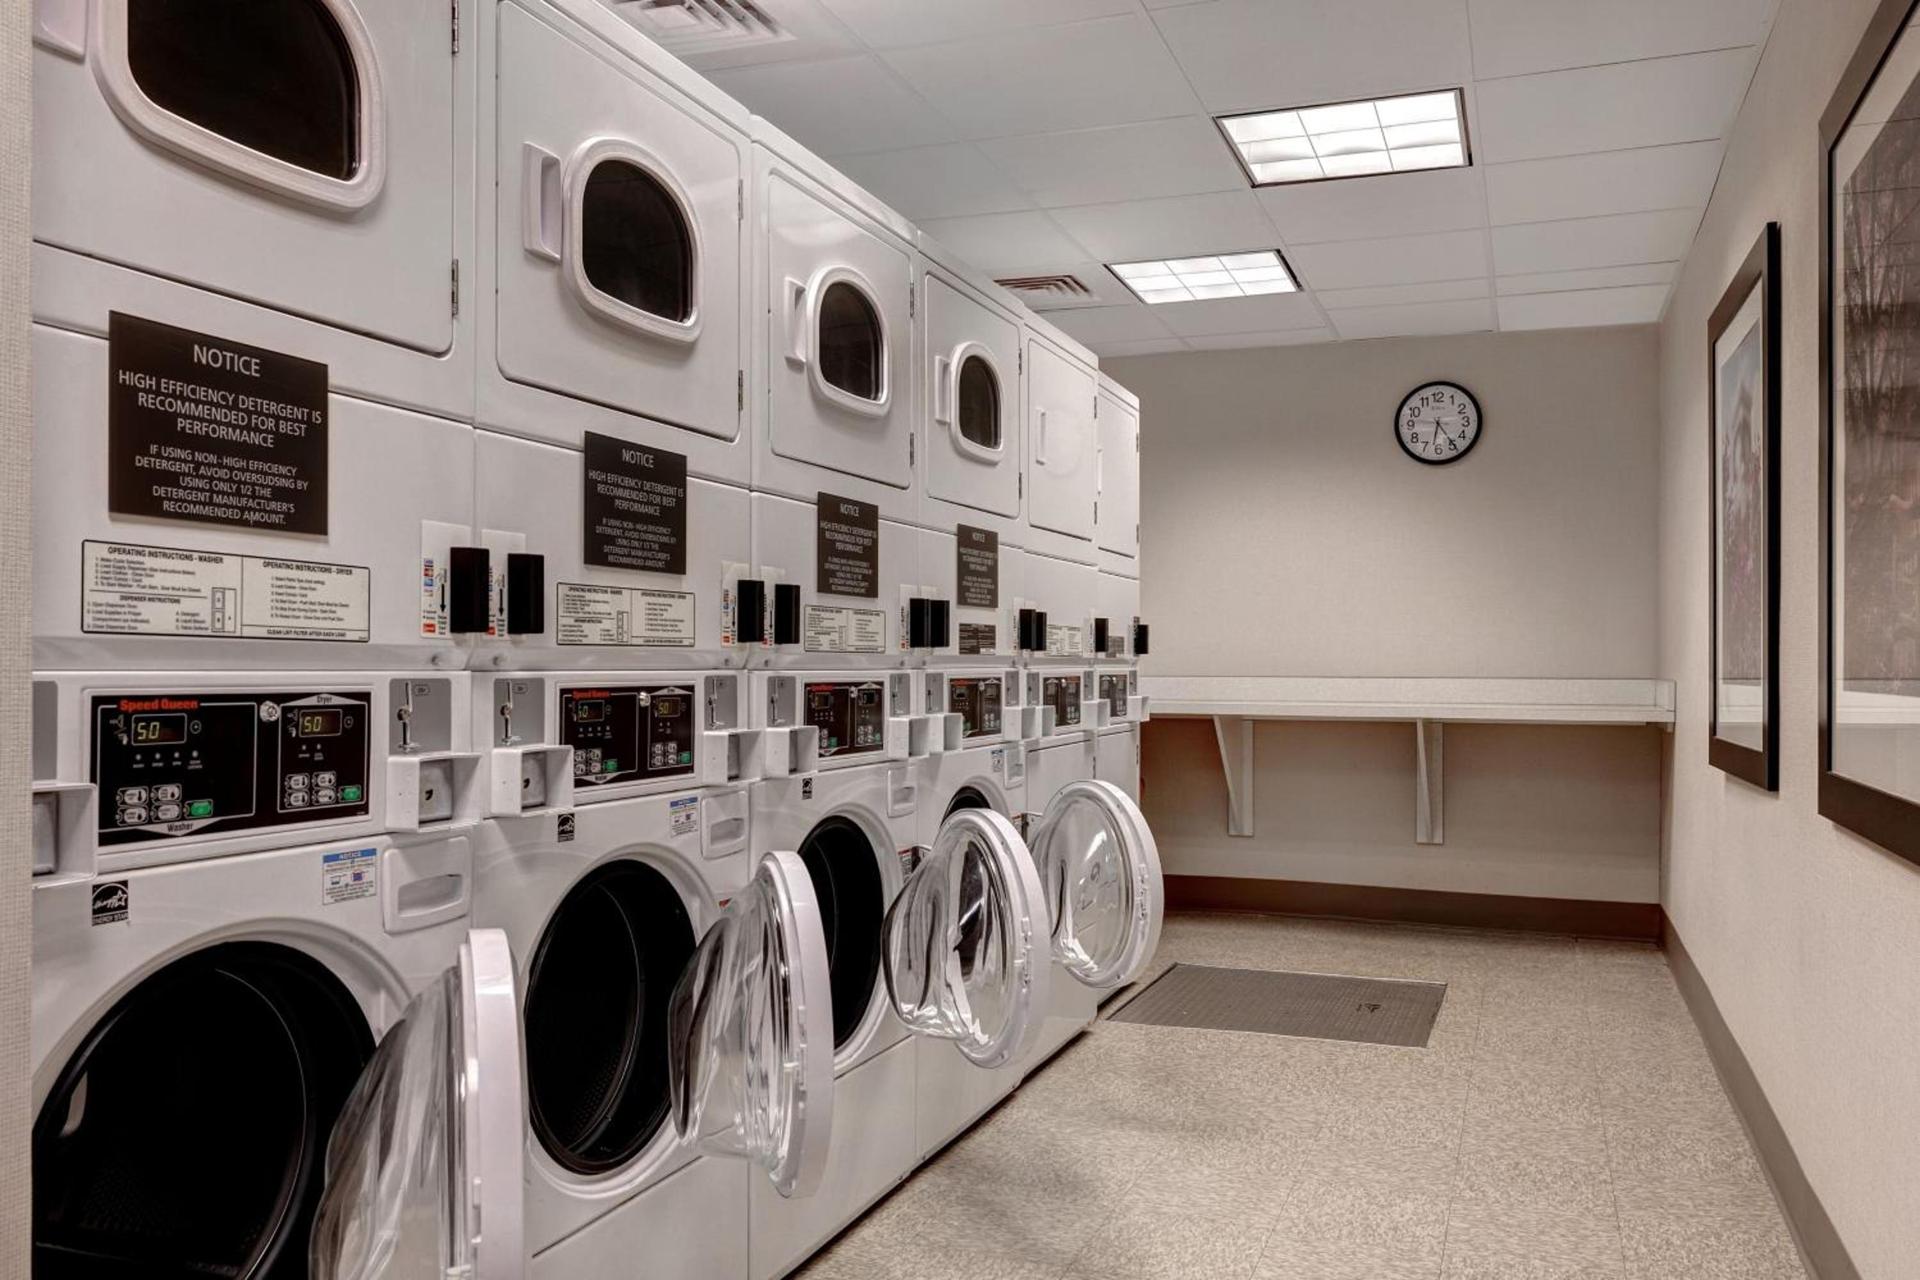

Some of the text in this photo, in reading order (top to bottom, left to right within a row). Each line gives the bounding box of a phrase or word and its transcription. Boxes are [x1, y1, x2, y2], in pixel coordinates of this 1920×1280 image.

[193, 344, 261, 377] NOTICE
[118, 369, 322, 424] HIGH EFFICIENCY DETERGENT IS
[1420, 396, 1429, 407] 11
[1431, 391, 1444, 402] 12
[1449, 395, 1454, 405] 1
[1409, 407, 1420, 418] 10
[1458, 403, 1466, 414] 2
[138, 392, 307, 437] RECOMMENDED FOR BEST
[1407, 419, 1415, 430] 9
[1462, 416, 1470, 427] 3
[177, 418, 275, 448] PERFORMANCE
[1411, 432, 1418, 443] 8
[1458, 430, 1466, 440] 4
[1421, 441, 1428, 452] 7
[1435, 444, 1443, 455] 6
[1448, 440, 1456, 451] 5
[150, 444, 158, 455] IF
[161, 446, 192, 461] USING
[249, 459, 297, 477] EFFICIENCY
[622, 448, 654, 468] NOTICE
[199, 465, 230, 480] AVOID
[232, 469, 295, 489] OVERSUDSING
[296, 479, 308, 491] BY
[588, 469, 606, 481] HIGH
[607, 472, 641, 488] EFFICIENCY
[643, 481, 677, 496] DETERGENT
[180, 476, 210, 490] USING
[212, 480, 237, 495] ONLY
[254, 485, 272, 498] THE
[152, 485, 210, 503] DETERGENT
[597, 483, 648, 501] RECOMMENDED
[649, 494, 661, 505] FOR
[163, 501, 241, 520] RECOMMENDED
[615, 499, 660, 516] PERFORMANCE
[108, 546, 146, 557] OPERATING
[198, 555, 224, 564] WASHER
[263, 561, 293, 570] OPERATING
[119, 700, 198, 711] Speed Queen
[167, 822, 194, 832] Washer
